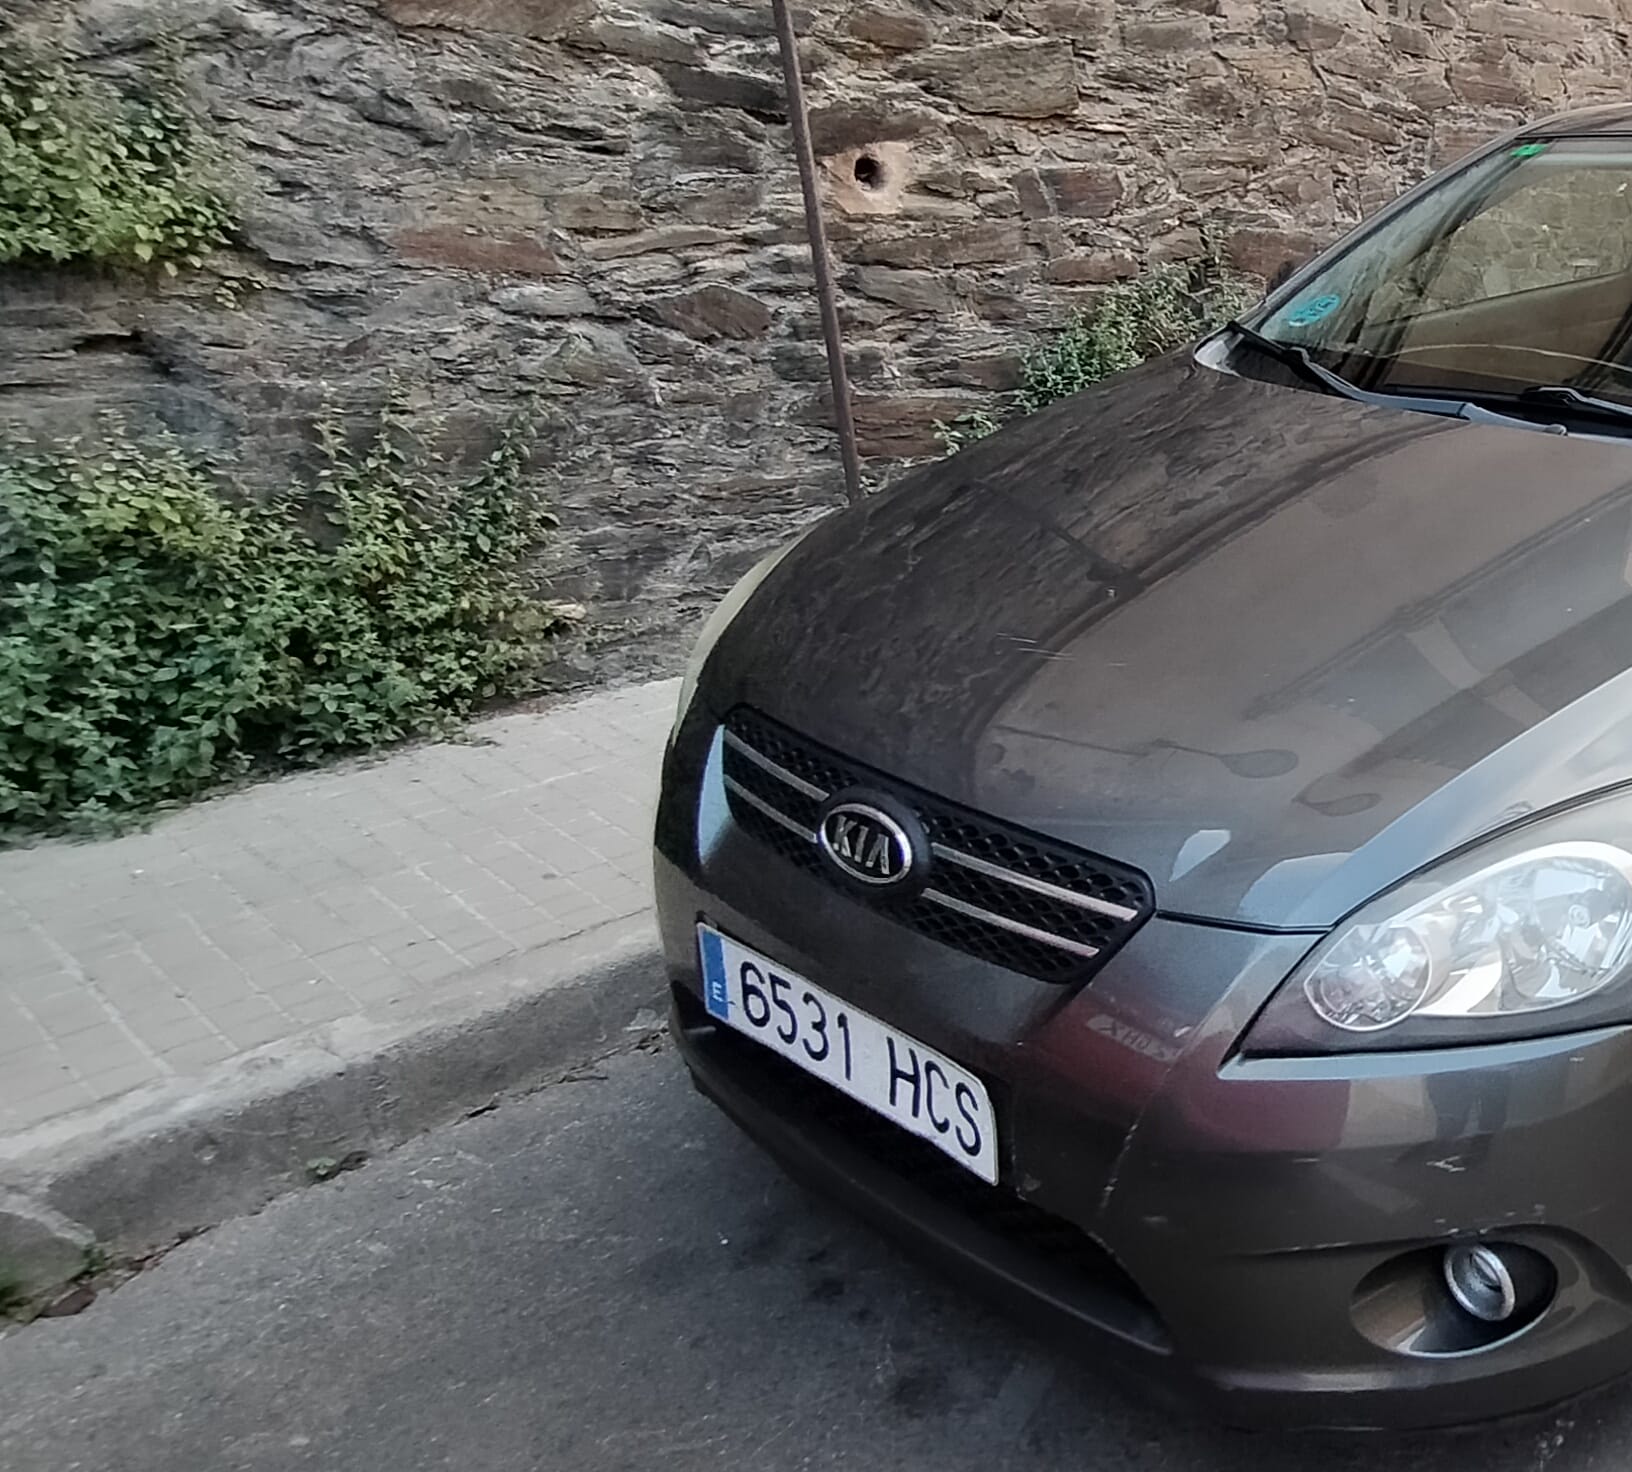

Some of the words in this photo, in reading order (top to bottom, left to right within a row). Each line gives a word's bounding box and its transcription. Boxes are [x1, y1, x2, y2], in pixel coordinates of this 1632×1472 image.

[832, 814, 890, 875] KIA
[711, 981, 724, 1002] E
[740, 961, 851, 1081] 6531
[886, 1036, 982, 1157] HCS
